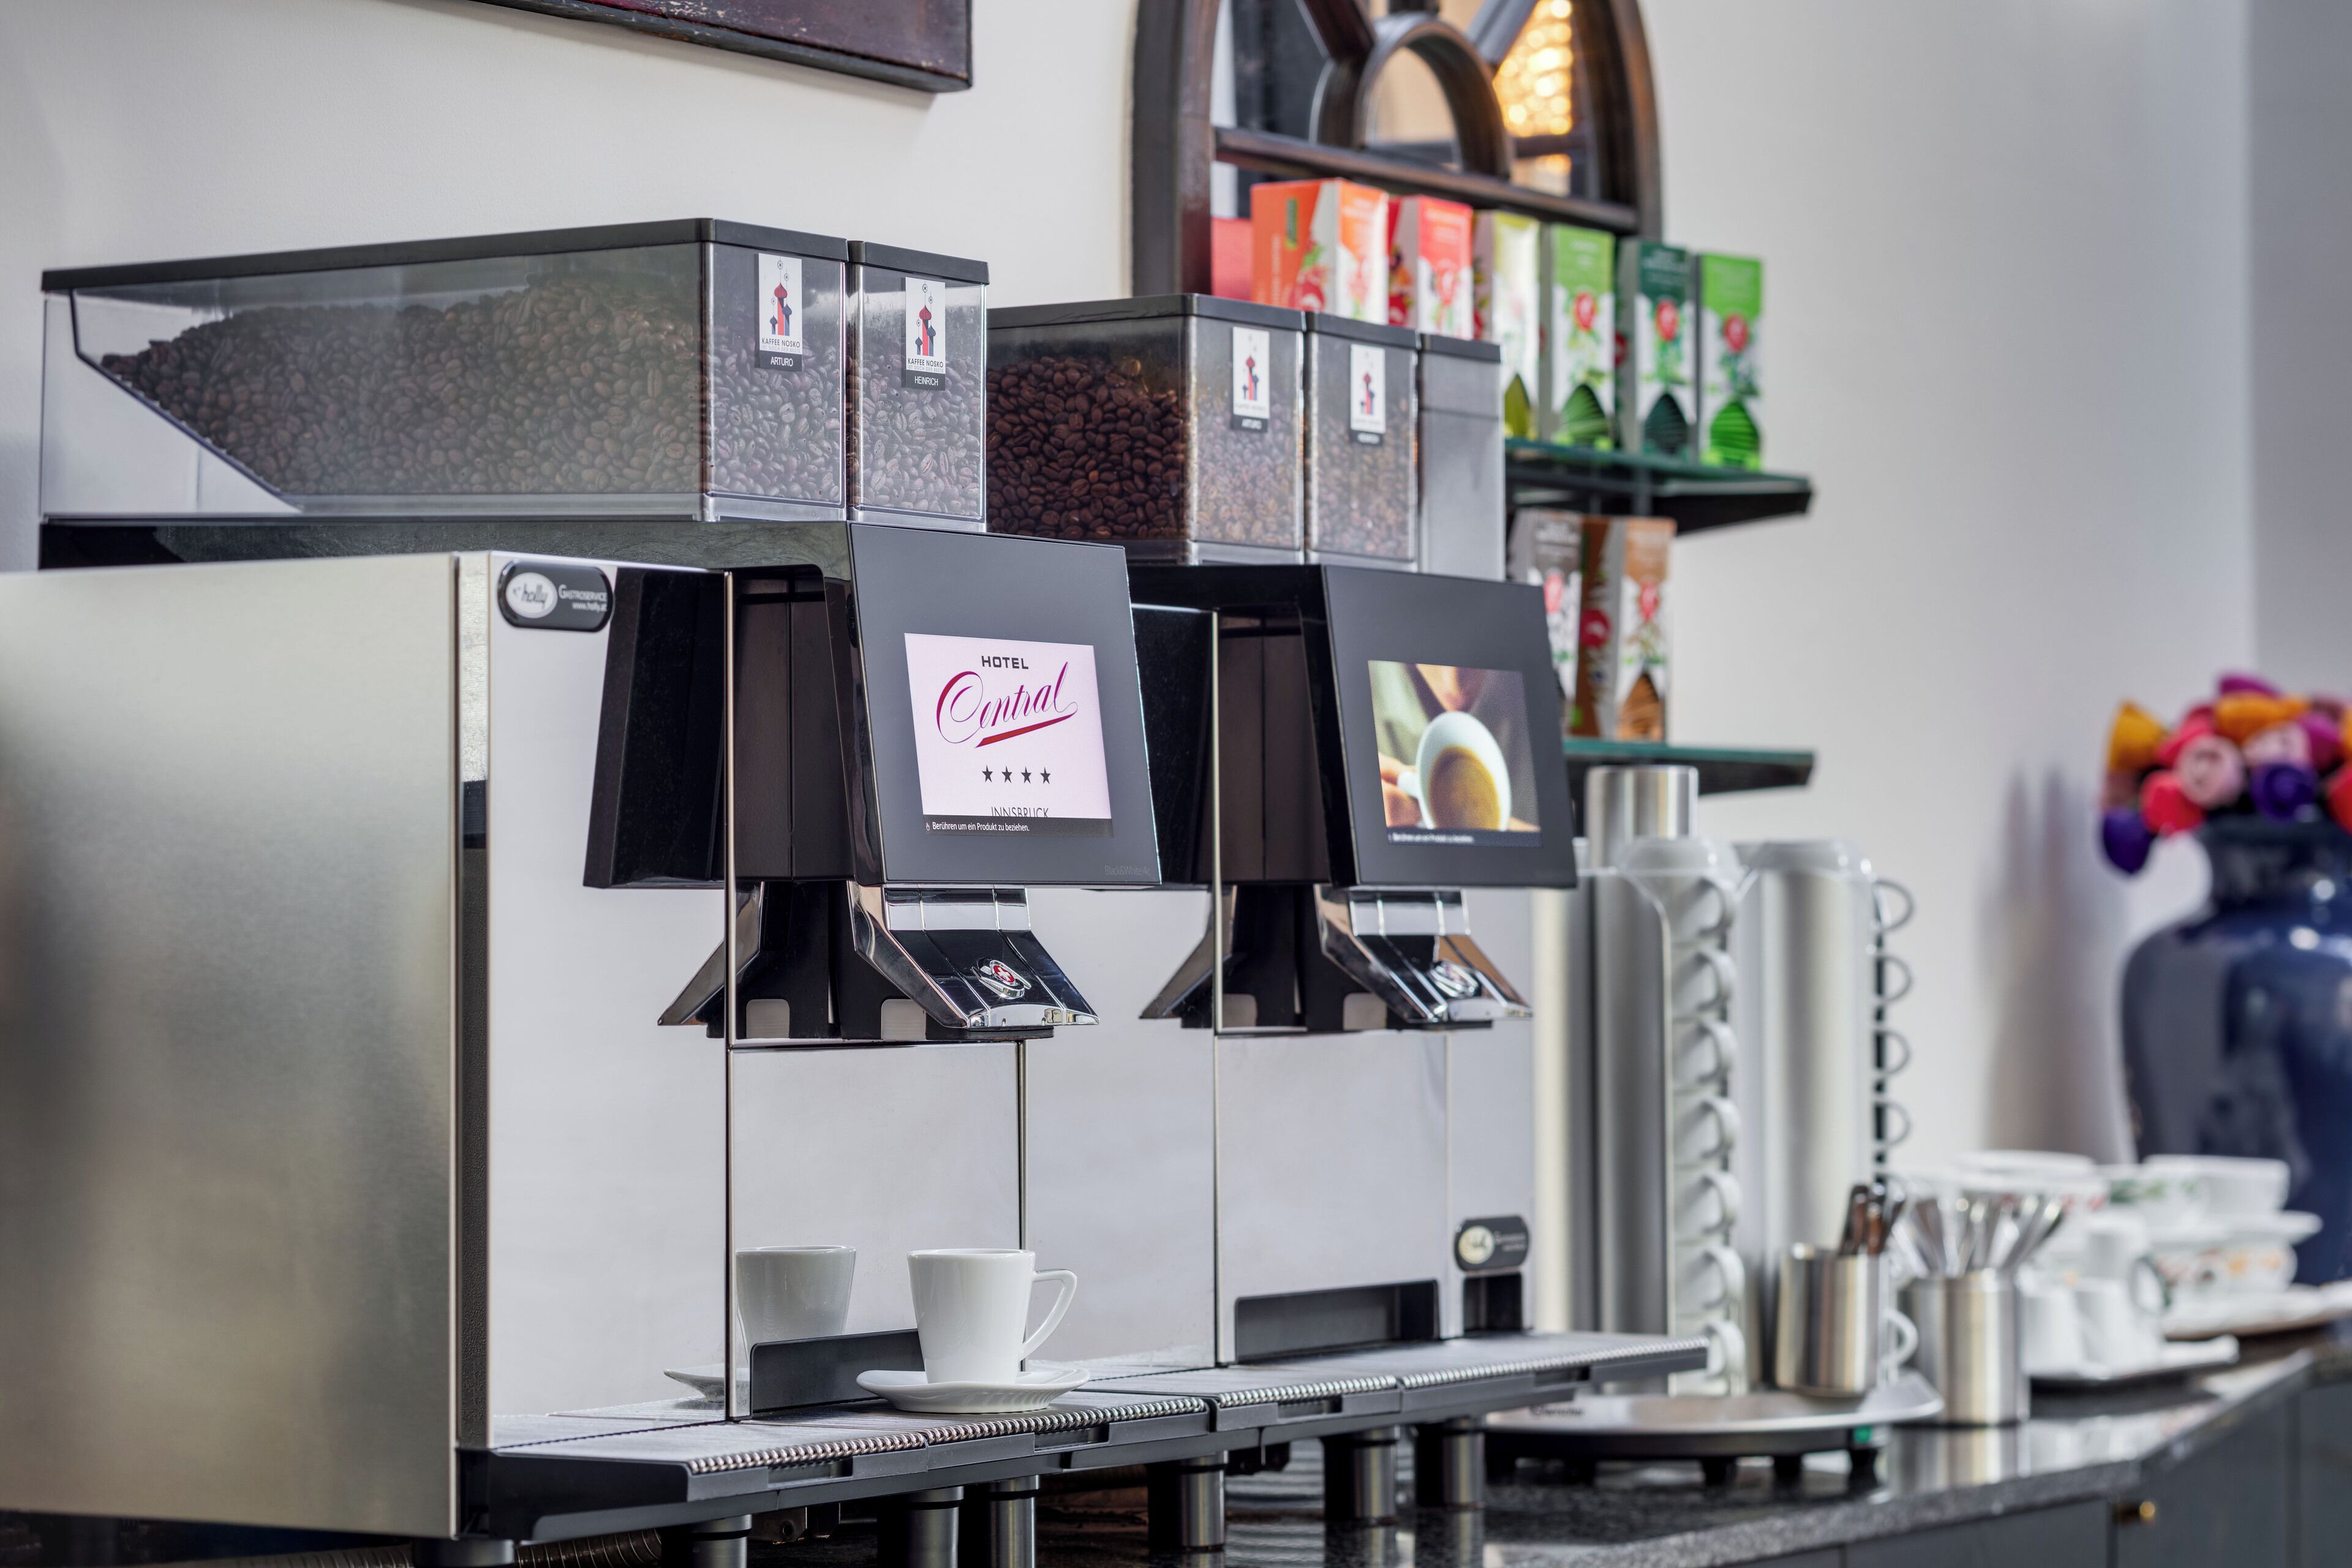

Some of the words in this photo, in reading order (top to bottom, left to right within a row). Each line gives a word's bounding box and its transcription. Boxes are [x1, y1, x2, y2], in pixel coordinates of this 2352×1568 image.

[761, 337, 780, 346] KAFFEE
[782, 339, 801, 348] NOSKO
[771, 356, 793, 367] ARTURO
[908, 357, 924, 366] KAFFEE
[914, 375, 938, 386] HEINRICH
[521, 582, 548, 610] holly
[571, 601, 608, 612] www.holly.at
[981, 655, 1029, 669] HOTEL
[936, 662, 1079, 748] Central
[991, 806, 1049, 818] INNSBRUCK
[932, 822, 957, 831] Berühren
[977, 823, 997, 831] Produkt
[1005, 823, 1030, 832] beziehen.
